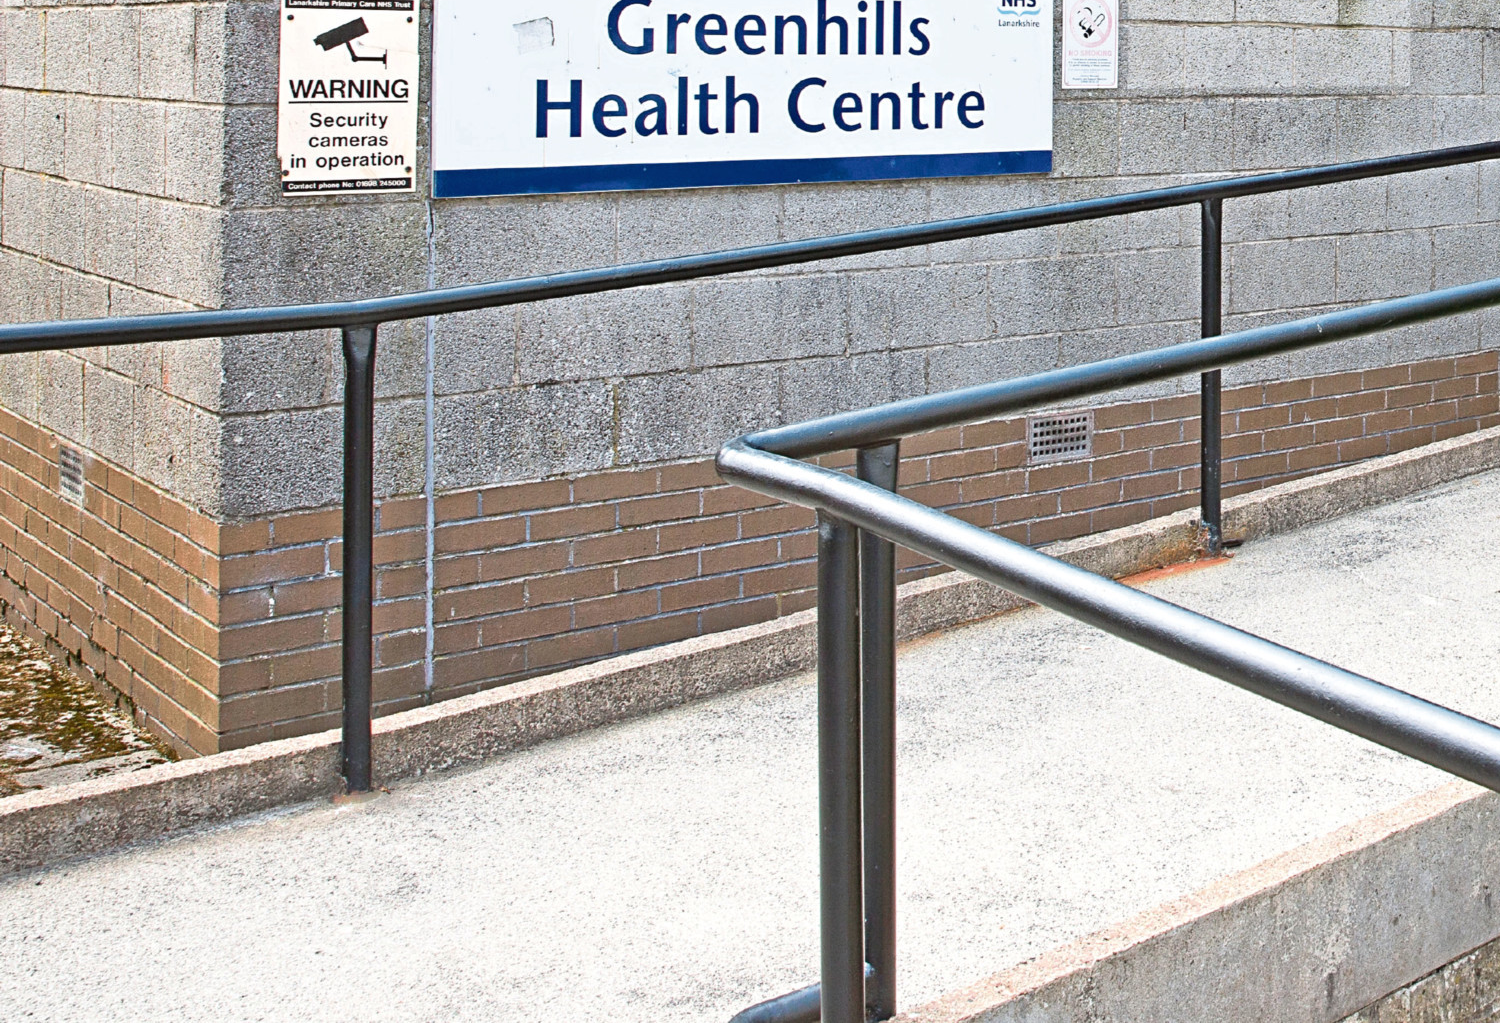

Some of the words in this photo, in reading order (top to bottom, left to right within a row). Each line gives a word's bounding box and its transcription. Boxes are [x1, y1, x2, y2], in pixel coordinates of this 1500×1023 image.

[332, 0, 356, 8] Primary
[998, 19, 1040, 27] Lanarkshire
[289, 79, 409, 98] WARNING
[536, 75, 759, 137] Health
[787, 77, 985, 133] Centre
[310, 113, 388, 129] Security
[309, 135, 388, 147] cameras
[291, 154, 306, 168] in
[316, 153, 404, 170] operation
[319, 181, 340, 189] phone
